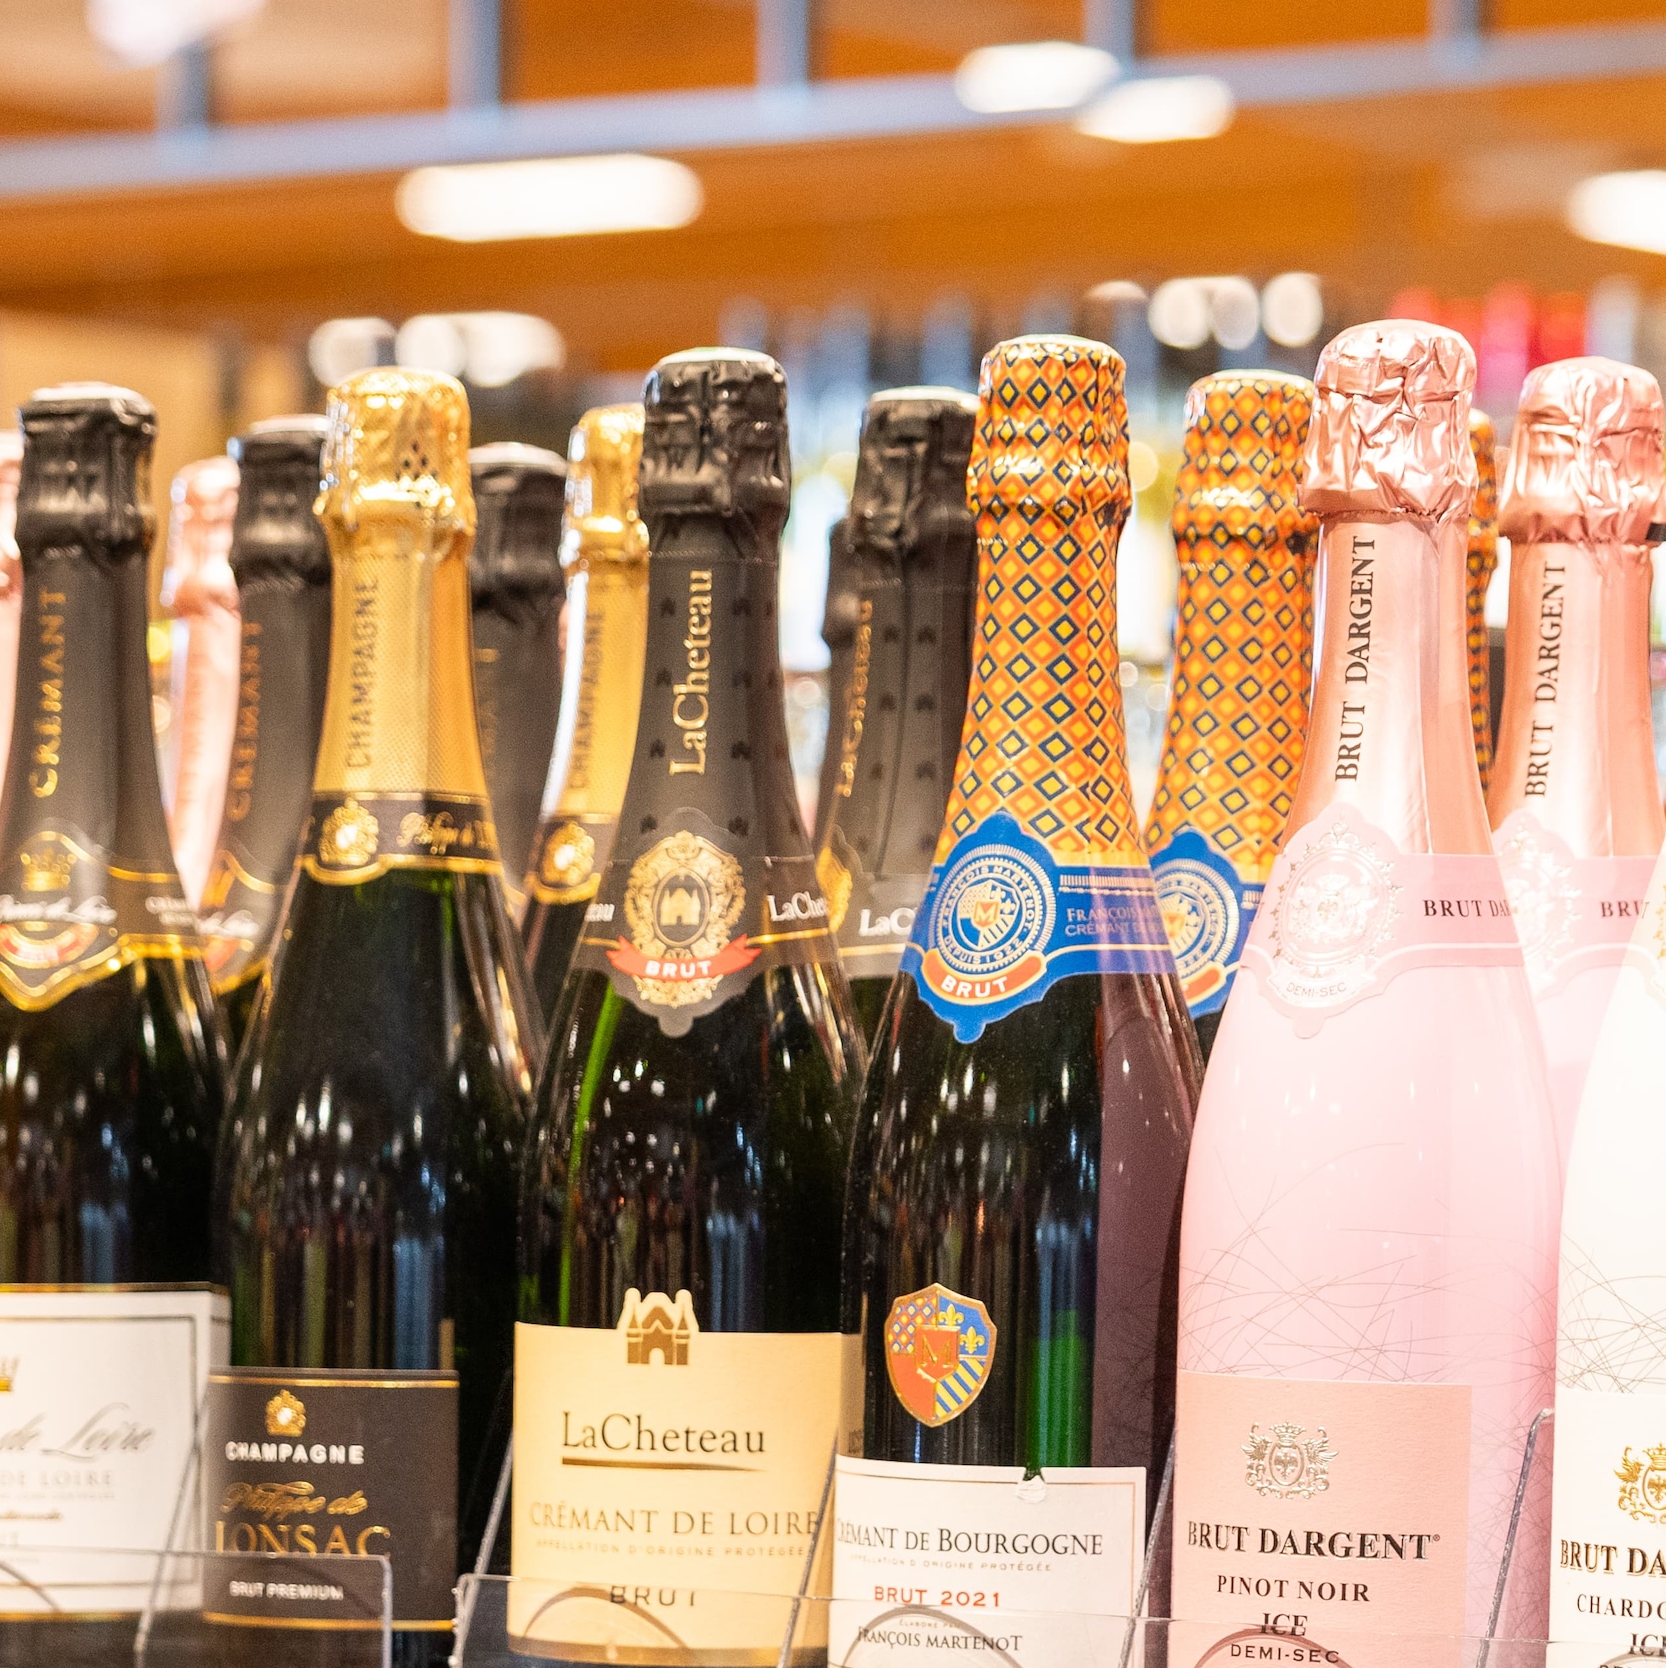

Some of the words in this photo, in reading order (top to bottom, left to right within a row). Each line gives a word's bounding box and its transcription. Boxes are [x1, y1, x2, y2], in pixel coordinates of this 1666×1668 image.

[1345, 535, 1375, 684] DARGENT
[1534, 560, 1566, 704] DARGENT
[347, 575, 379, 770] CHAMPAGNE
[669, 569, 713, 776] LaCheteau
[1334, 700, 1365, 784] BRUT
[1524, 721, 1553, 798] BRUT
[1424, 899, 1482, 918] BRUT
[943, 936, 982, 964] DEPUIS
[645, 959, 712, 978] BRUT
[941, 975, 1007, 998] BRUT
[561, 1411, 766, 1454] LaCheteau
[225, 1441, 365, 1464] CHAMPAGNE
[530, 1500, 659, 1533] CRÉMANT
[673, 1510, 714, 1536] DE
[730, 1511, 820, 1536] LOIRE
[535, 1538, 619, 1553] APPELLATION
[837, 1518, 898, 1549] CRÉMANT
[905, 1531, 930, 1550] DE
[937, 1528, 1103, 1556] BOURGOGNE
[1187, 1519, 1251, 1552] BRUT
[1258, 1528, 1431, 1561] DARGENT
[981, 1561, 1052, 1572] PROTÉGÉE
[1559, 1539, 1619, 1572] BRUT
[230, 1581, 265, 1597] BRUT
[266, 1583, 344, 1600] PREMIUM
[875, 1586, 927, 1605] BRUT
[941, 1591, 1000, 1607] 2021
[1216, 1574, 1290, 1599] PINOT
[1297, 1579, 1370, 1603] NOIR
[857, 1626, 920, 1649] FRANÇOIS
[926, 1632, 1023, 1651] MARTENOT
[1260, 1612, 1308, 1638] ICE
[1230, 1644, 1340, 1664] DEMI-SEC
